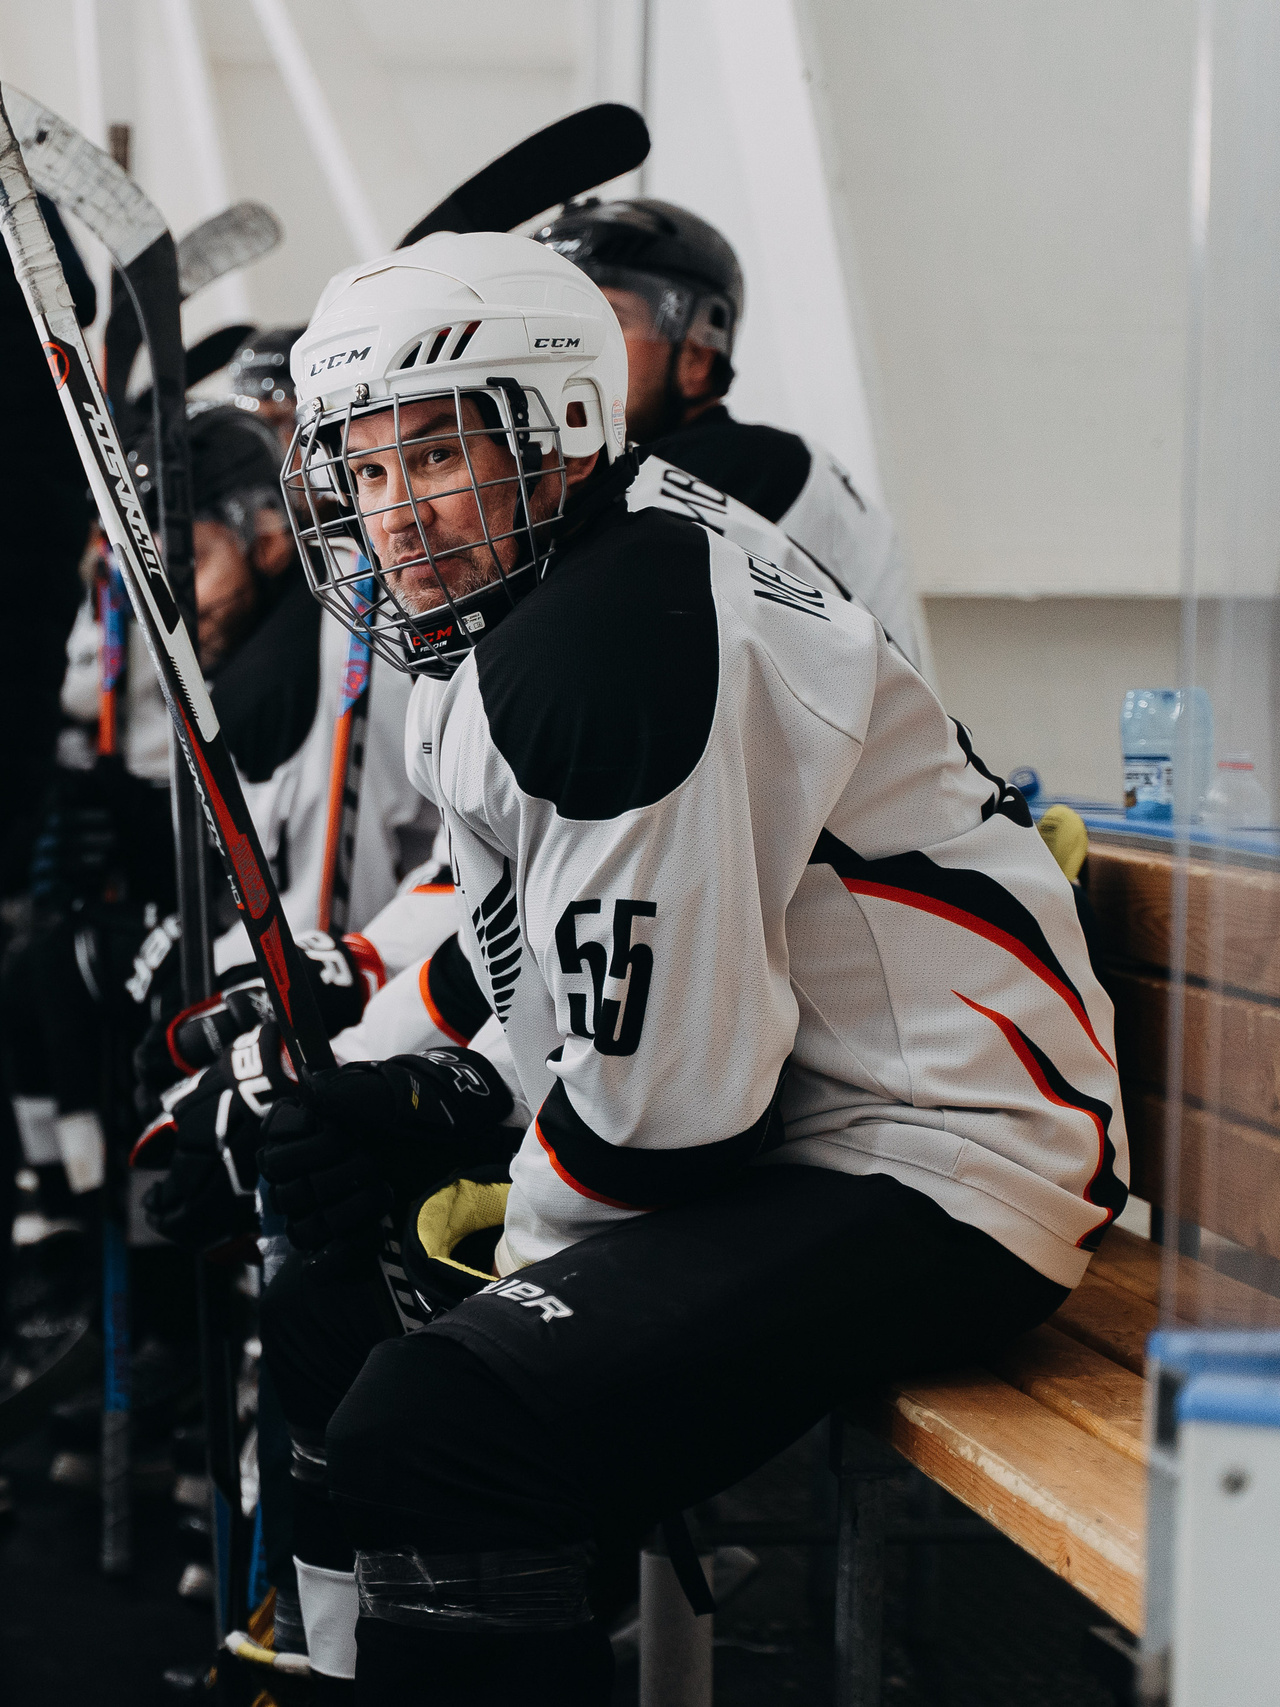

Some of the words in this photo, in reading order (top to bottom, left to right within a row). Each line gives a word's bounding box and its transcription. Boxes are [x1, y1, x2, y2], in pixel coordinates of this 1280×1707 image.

[534, 337, 581, 348] CCM
[310, 345, 372, 377] CCM
[82, 401, 162, 579] DYNASTY
[412, 625, 453, 647] CCM
[555, 899, 657, 1056] 55
